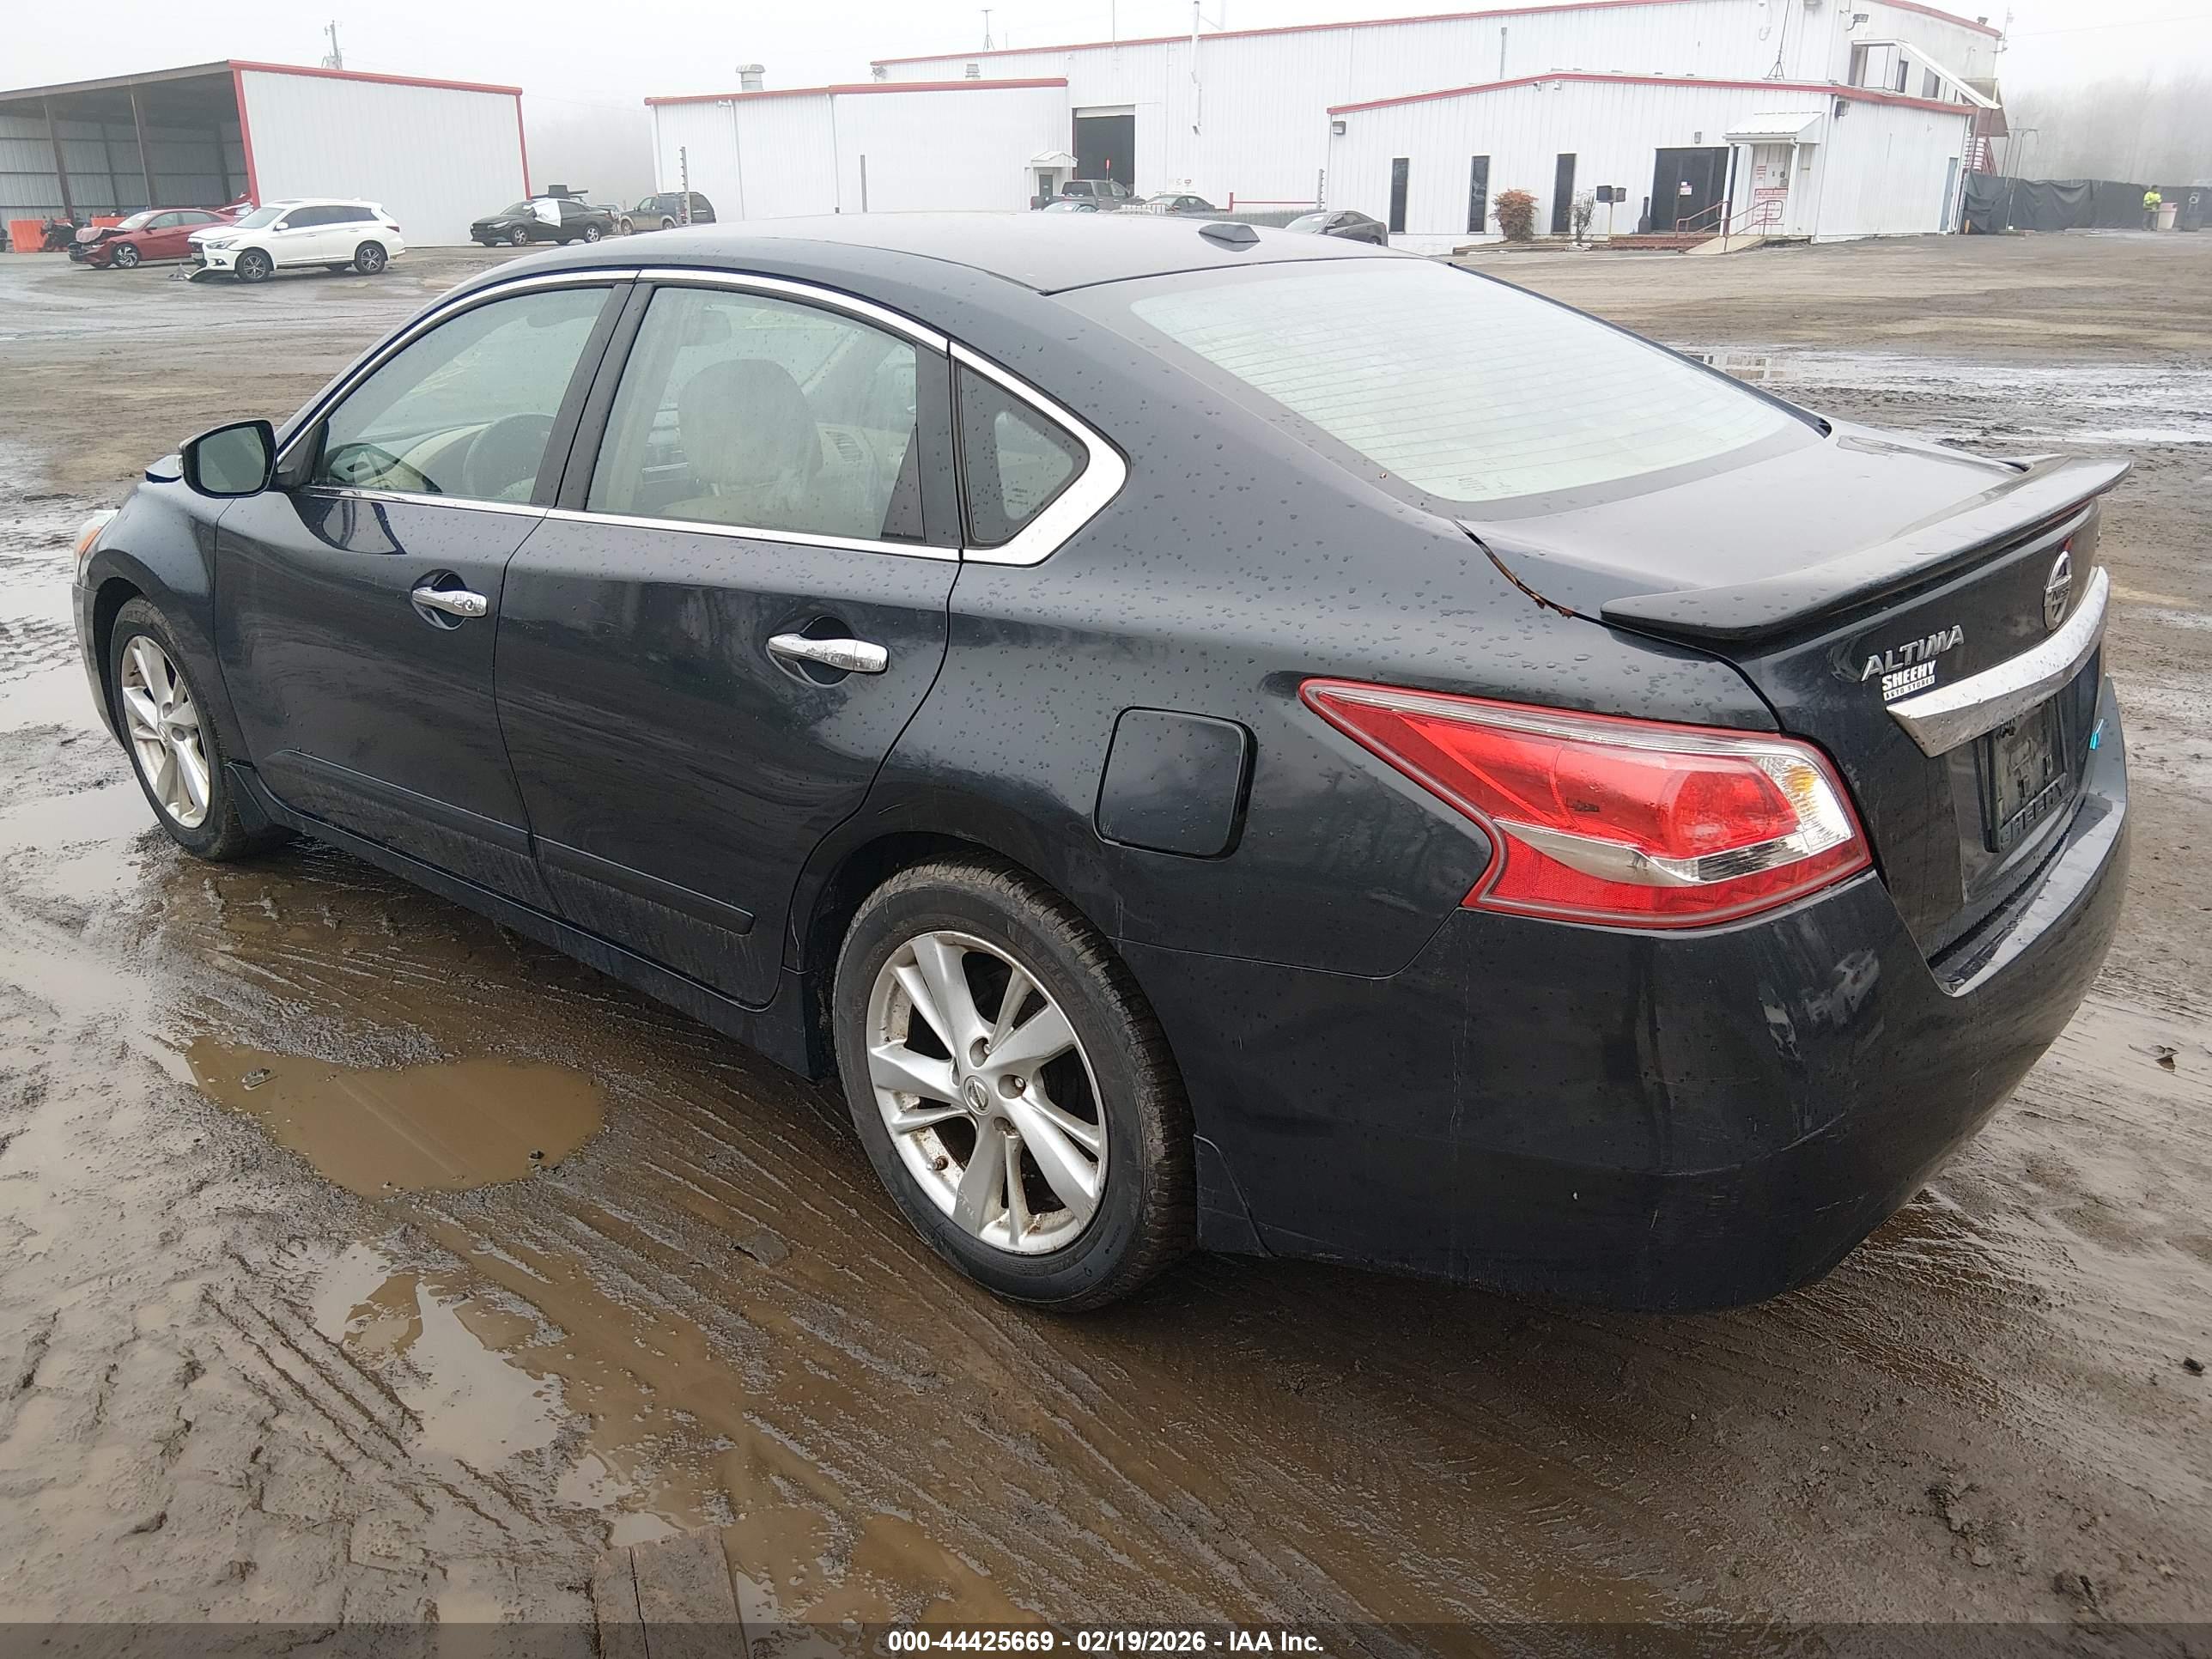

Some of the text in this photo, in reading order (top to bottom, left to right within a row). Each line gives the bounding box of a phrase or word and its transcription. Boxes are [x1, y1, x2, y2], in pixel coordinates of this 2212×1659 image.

[1860, 624, 1965, 682] ALTIMA
[1881, 659, 1936, 692] SHEEHY
[1907, 676, 1935, 692] STORES
